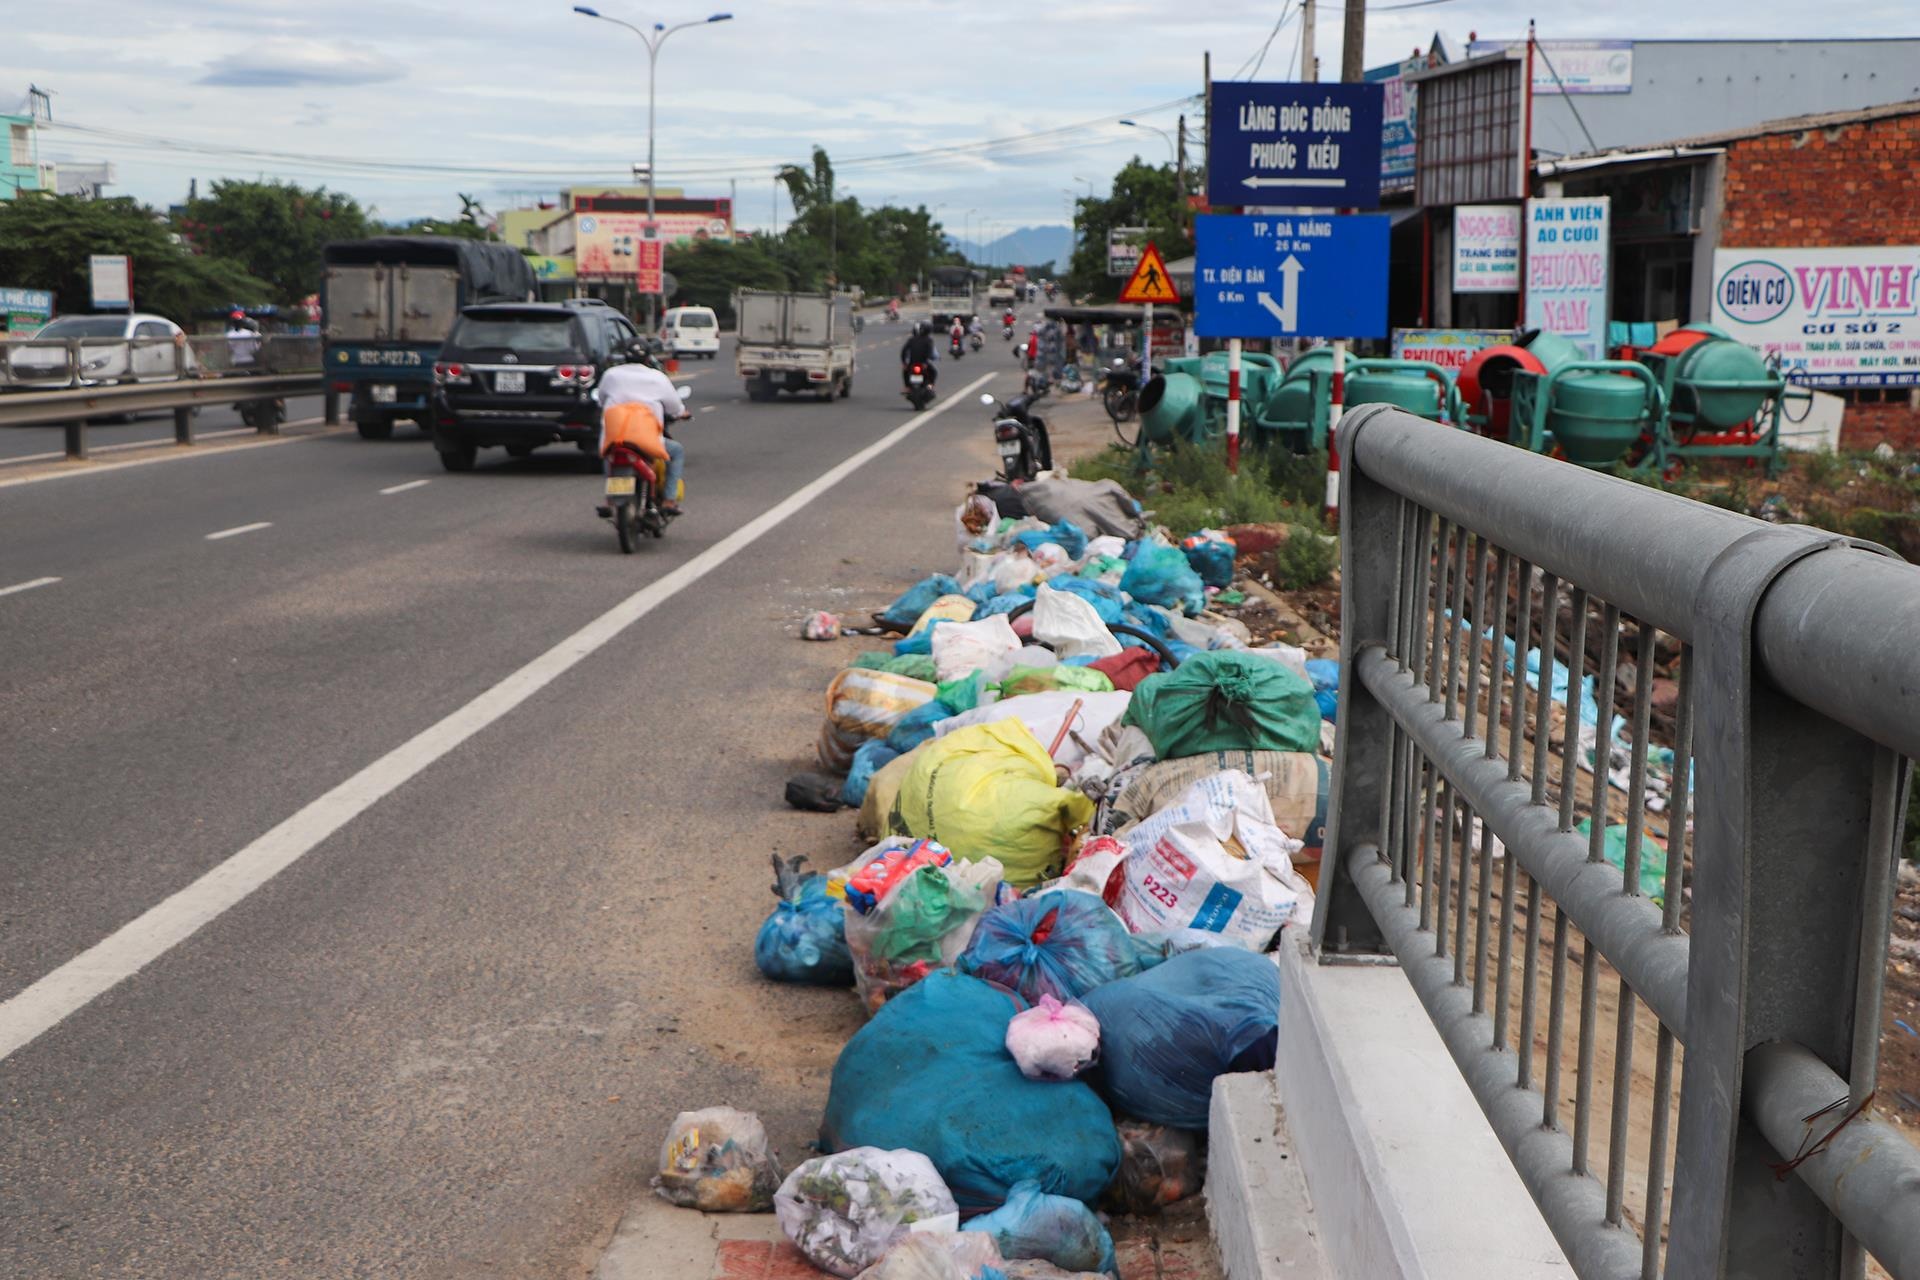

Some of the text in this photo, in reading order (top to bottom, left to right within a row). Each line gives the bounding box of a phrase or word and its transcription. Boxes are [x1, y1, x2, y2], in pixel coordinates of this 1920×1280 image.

[1239, 100, 1276, 132] LÀNG
[1250, 136, 1297, 169] PHƯỚC
[1253, 222, 1272, 238] TP.
[1292, 240, 1311, 252] Km
[1218, 291, 1245, 302] 6 Km
[1765, 276, 1786, 305] CƠ
[1794, 265, 1914, 310] VINH
[1886, 322, 1902, 334] 2
